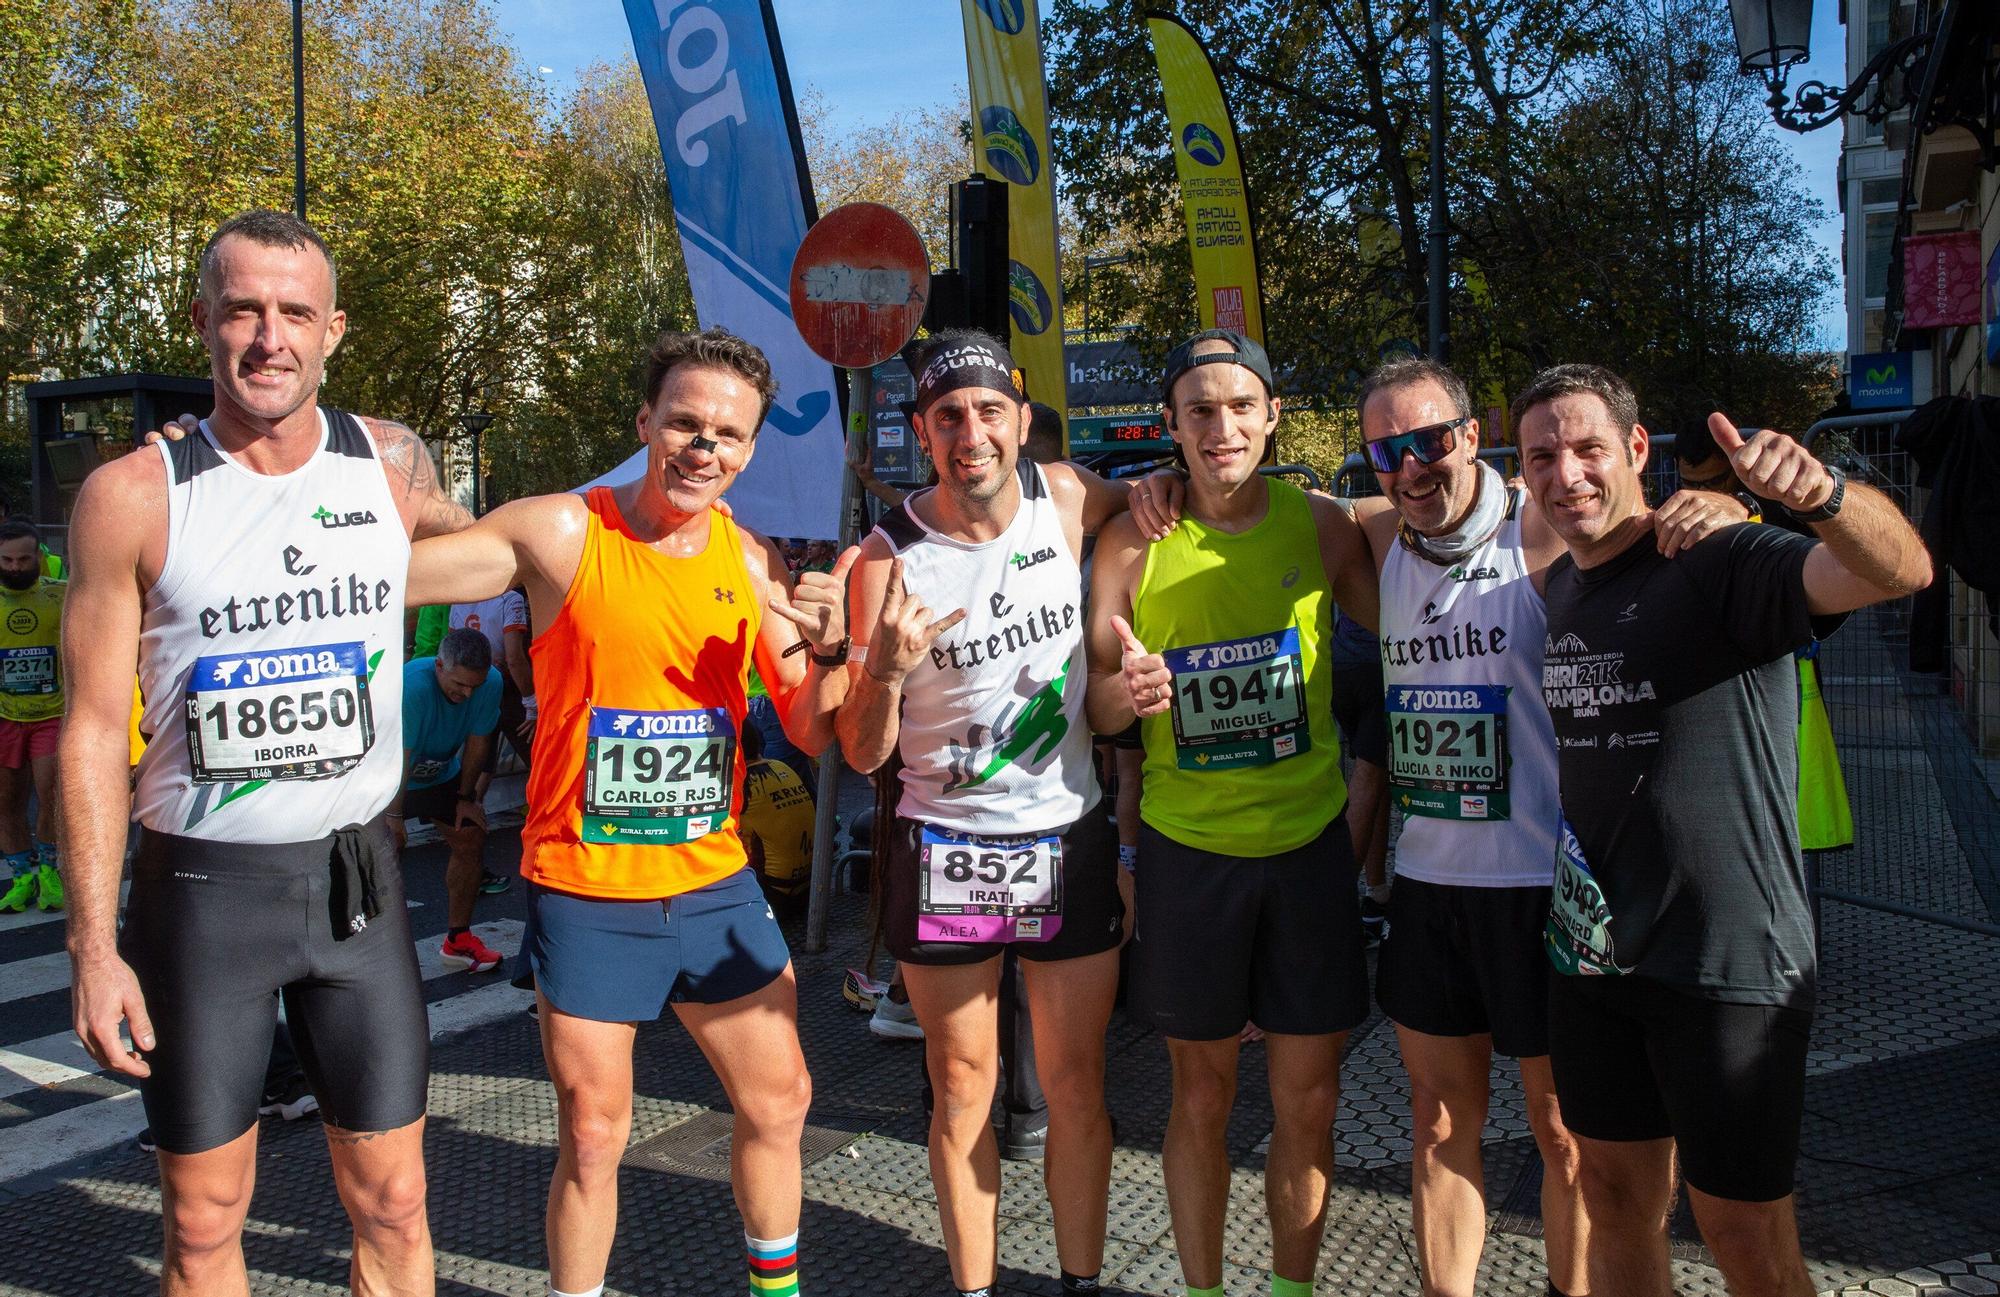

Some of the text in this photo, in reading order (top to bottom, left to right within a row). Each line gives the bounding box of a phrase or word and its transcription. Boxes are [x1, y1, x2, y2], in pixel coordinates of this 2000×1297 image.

[1858, 386, 1904, 397] movistar
[1117, 424, 1160, 439] 1:28:12
[321, 511, 377, 528] LUGA
[1017, 547, 1057, 571] LUGA
[199, 573, 391, 639] etxenike
[930, 603, 1074, 670] etxenike
[18, 648, 48, 657] Joma
[1208, 638, 1279, 668] Joma
[5, 658, 51, 674] 2371
[244, 651, 340, 685] Joma
[1182, 662, 1290, 714] 1947
[1546, 680, 1656, 708] PAMPLONA
[186, 699, 200, 719] 13
[1412, 689, 1482, 712] Joma
[206, 688, 356, 740] 18650
[1210, 711, 1276, 730] MIGUEL
[1574, 705, 1600, 718] IRUÑA
[637, 714, 714, 738] Joma
[1395, 718, 1488, 758] 1921
[254, 743, 318, 762] IBORRA
[588, 743, 596, 760] 3
[602, 744, 722, 784] 1924
[1396, 760, 1494, 780] LUCIA & NIKO
[922, 848, 928, 862] 2
[944, 850, 1038, 884] 852
[970, 890, 1014, 904] IRATI
[939, 926, 979, 938] ALEA
